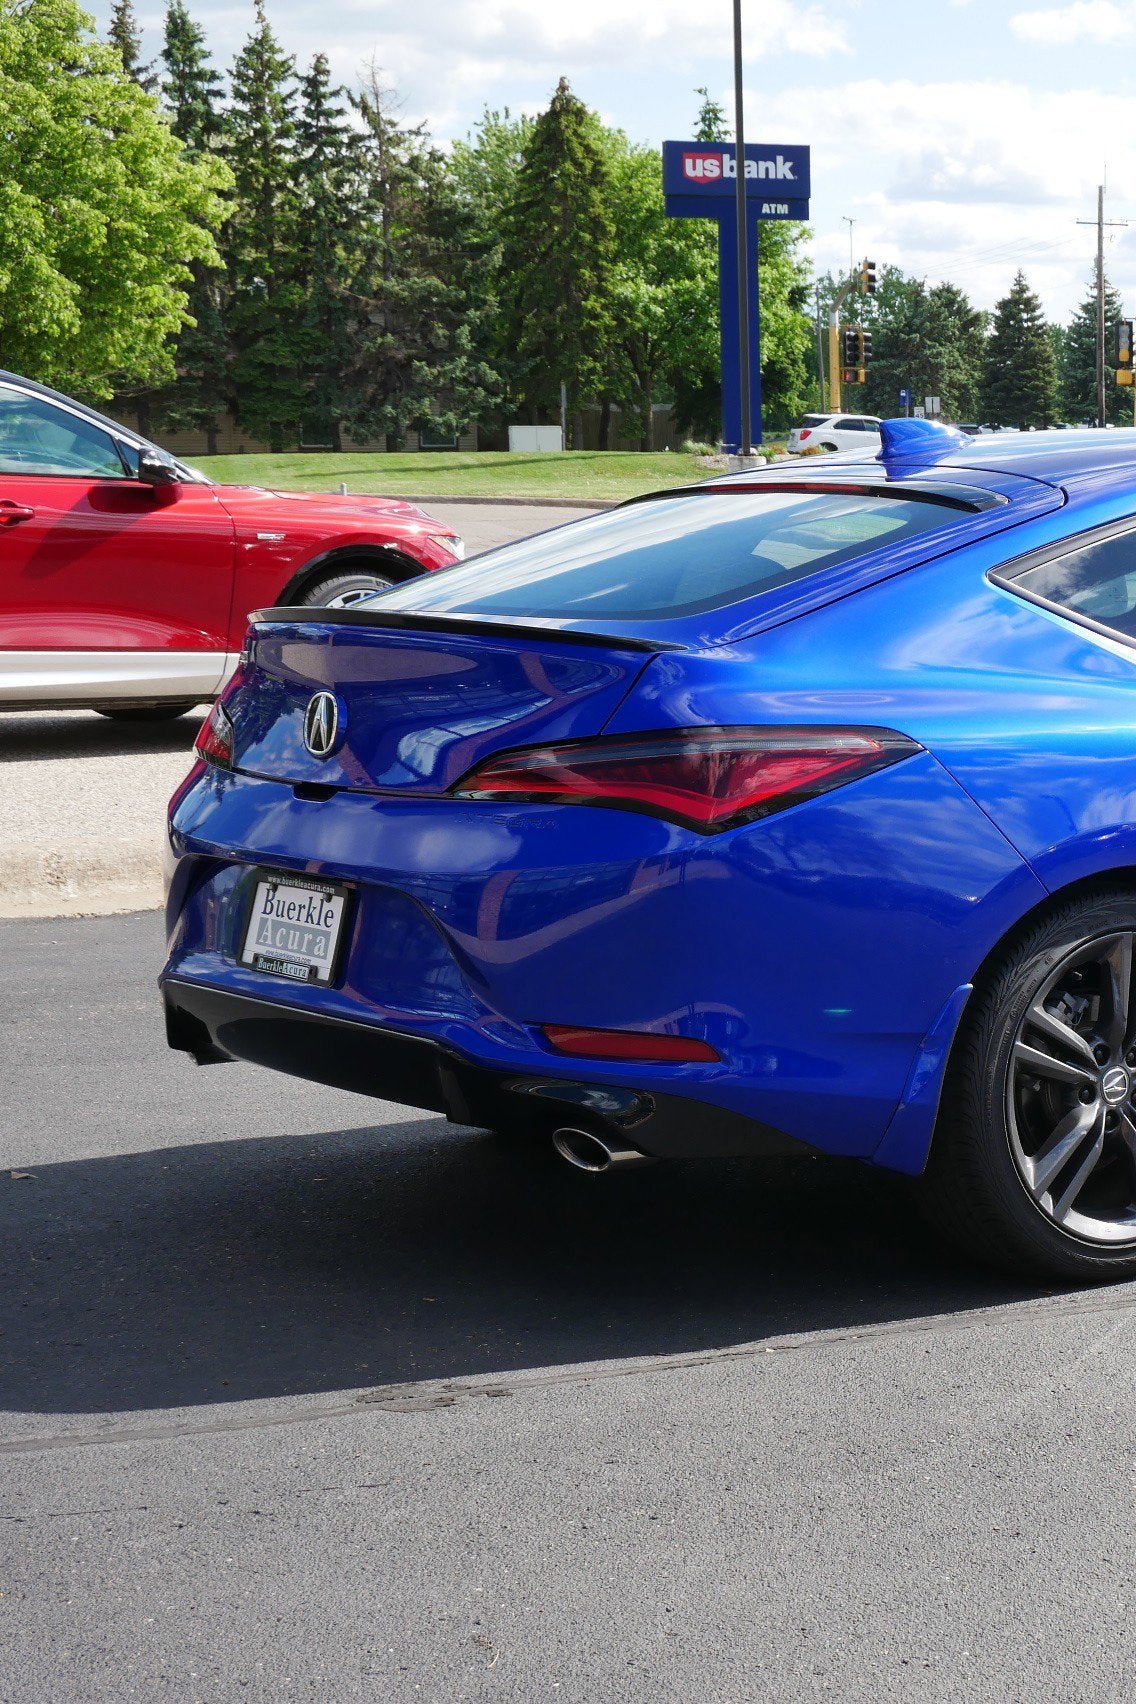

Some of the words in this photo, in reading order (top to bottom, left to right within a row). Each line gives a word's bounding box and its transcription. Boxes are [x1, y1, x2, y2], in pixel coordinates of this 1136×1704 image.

[762, 203, 788, 214] ATM
[267, 876, 336, 894] www.buerkleacura.com
[261, 888, 335, 929] Buerkle
[258, 918, 326, 957] Acura
